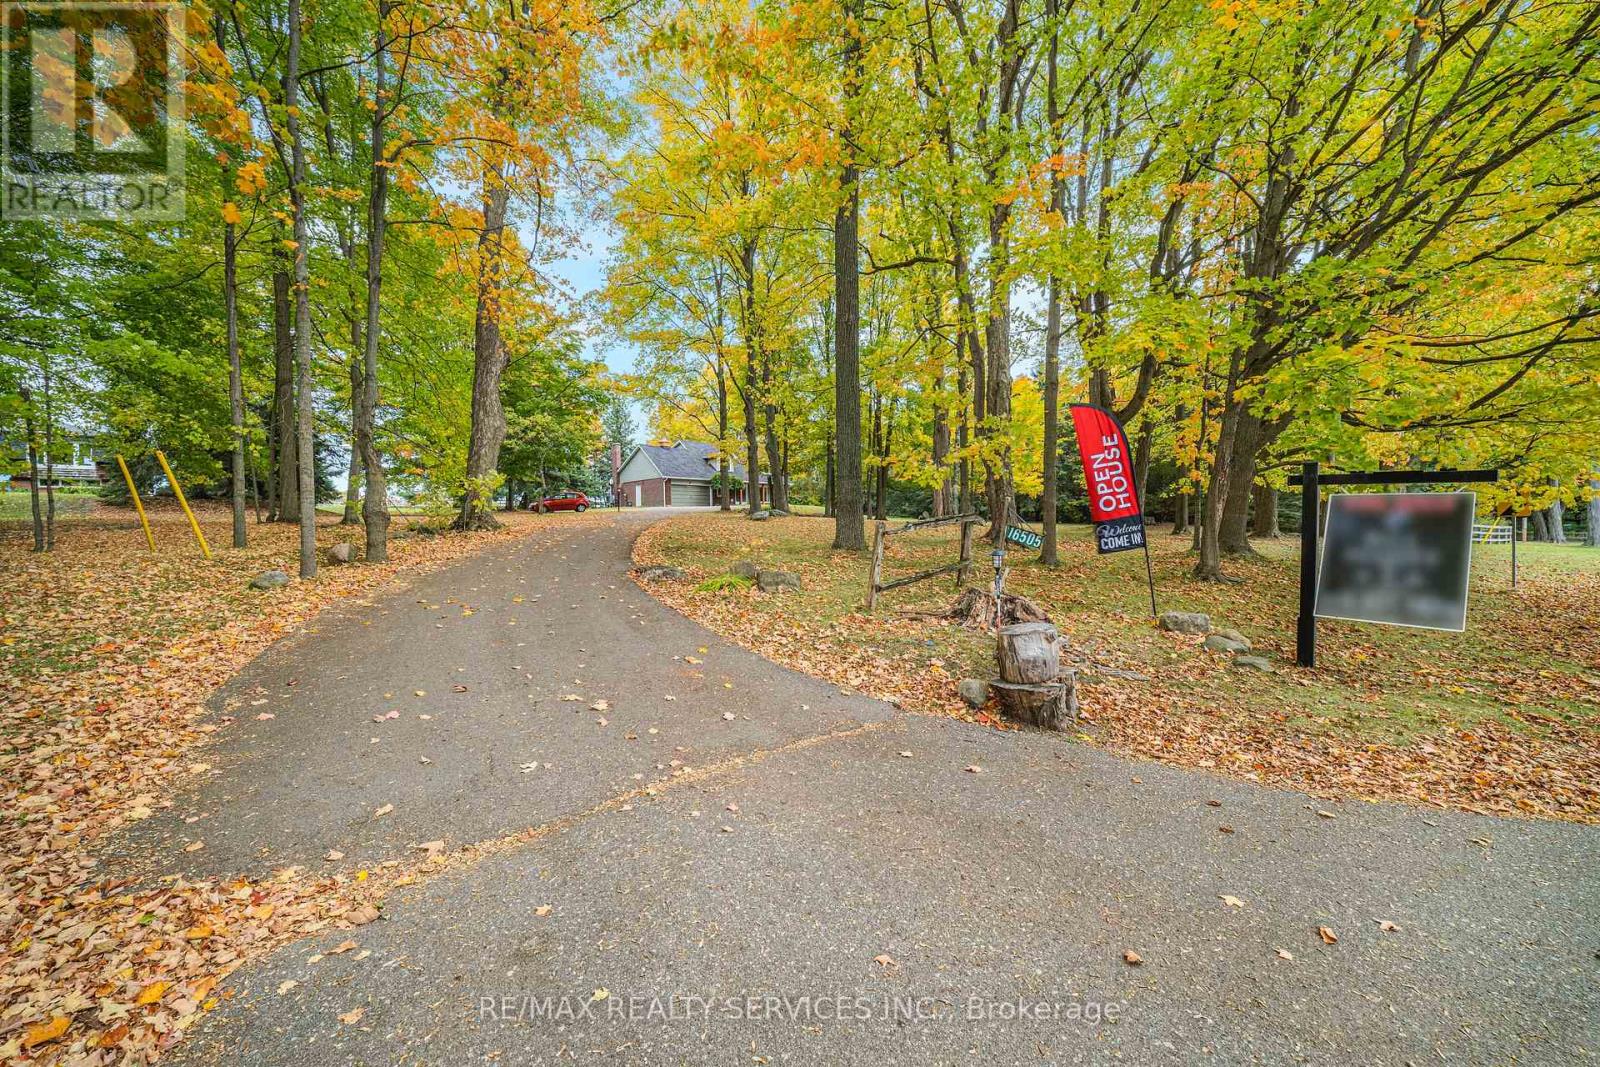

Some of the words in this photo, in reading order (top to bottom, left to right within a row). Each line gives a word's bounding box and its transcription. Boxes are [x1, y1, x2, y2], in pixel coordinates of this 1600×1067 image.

[1090, 453, 1117, 512] OPEN
[1102, 433, 1131, 509] HOUSE
[1007, 527, 1042, 548] 16505
[1101, 535, 1130, 550] COME
[1131, 532, 1144, 545] IN!
